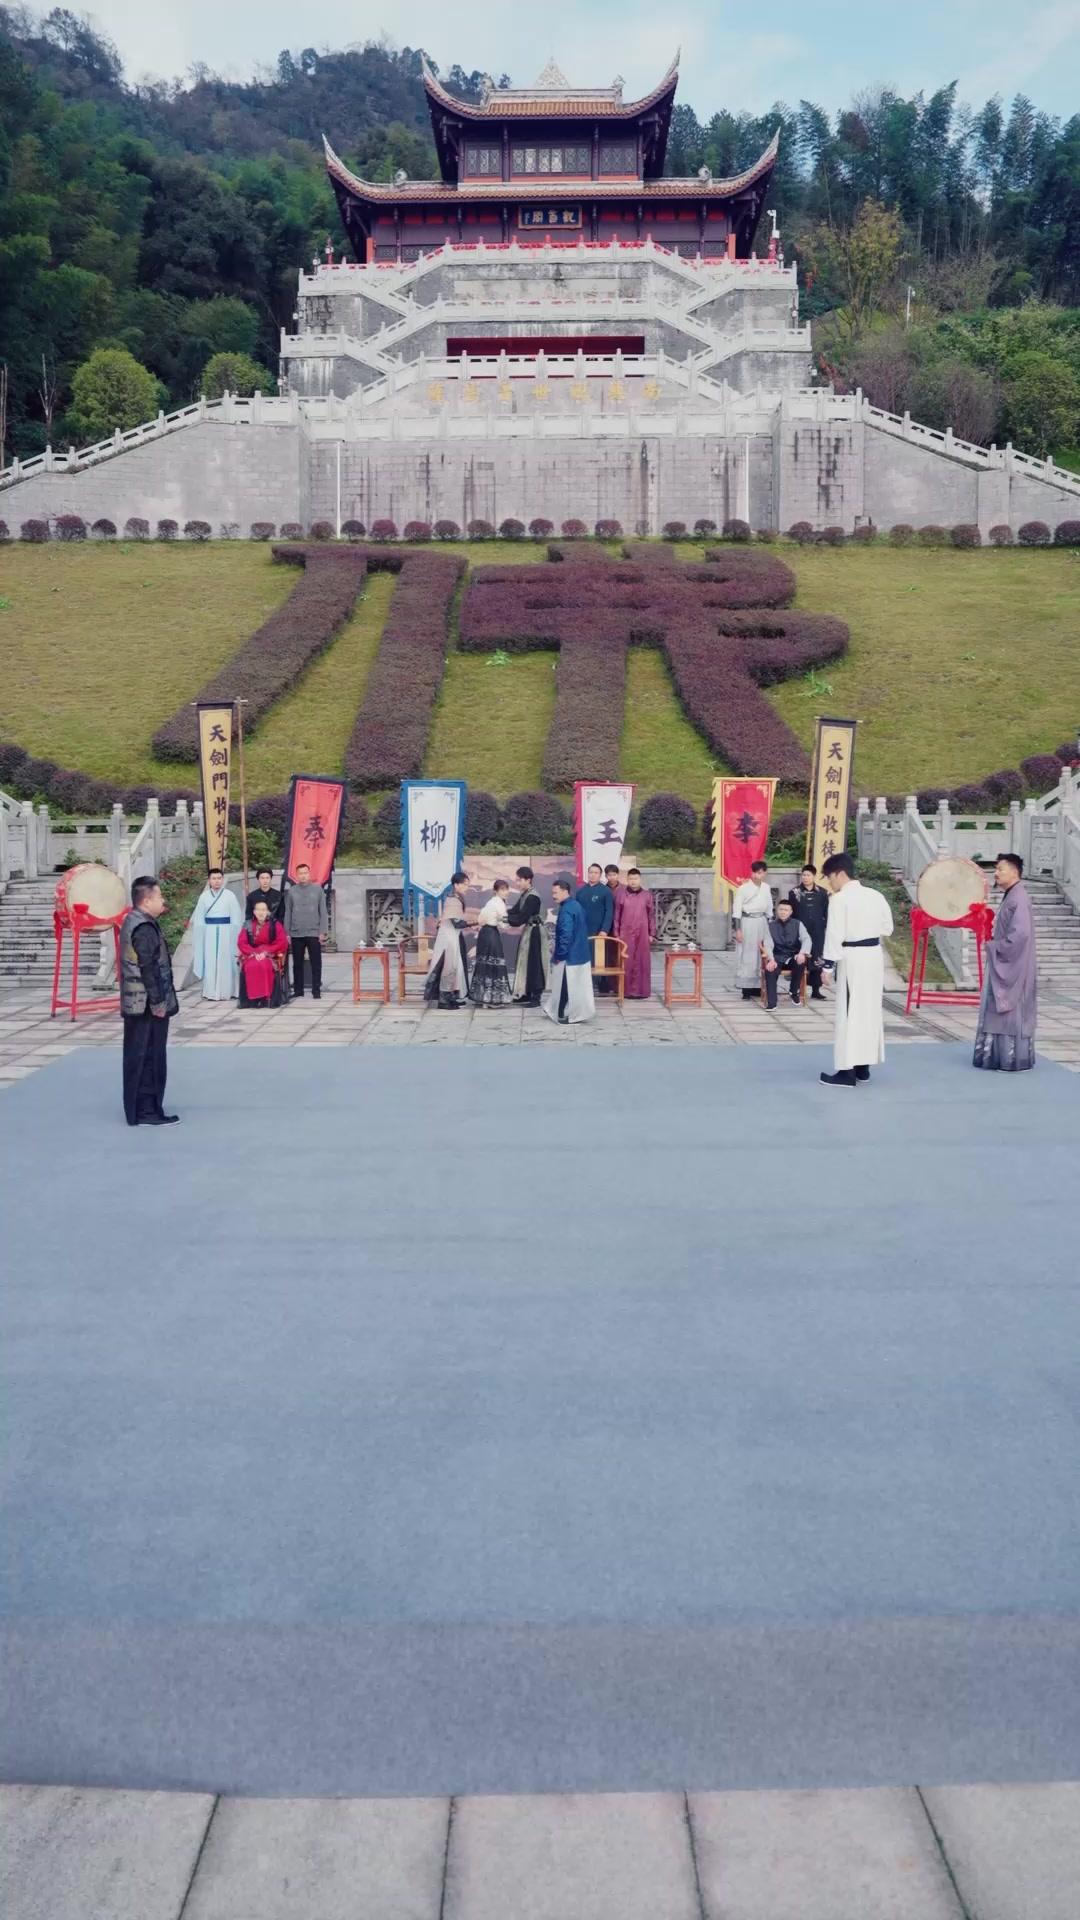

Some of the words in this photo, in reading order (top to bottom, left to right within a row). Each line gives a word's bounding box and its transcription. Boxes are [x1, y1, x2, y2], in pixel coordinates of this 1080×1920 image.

[420, 819, 446, 853] 柳
[592, 818, 623, 846] 王
[731, 810, 761, 843] 李
